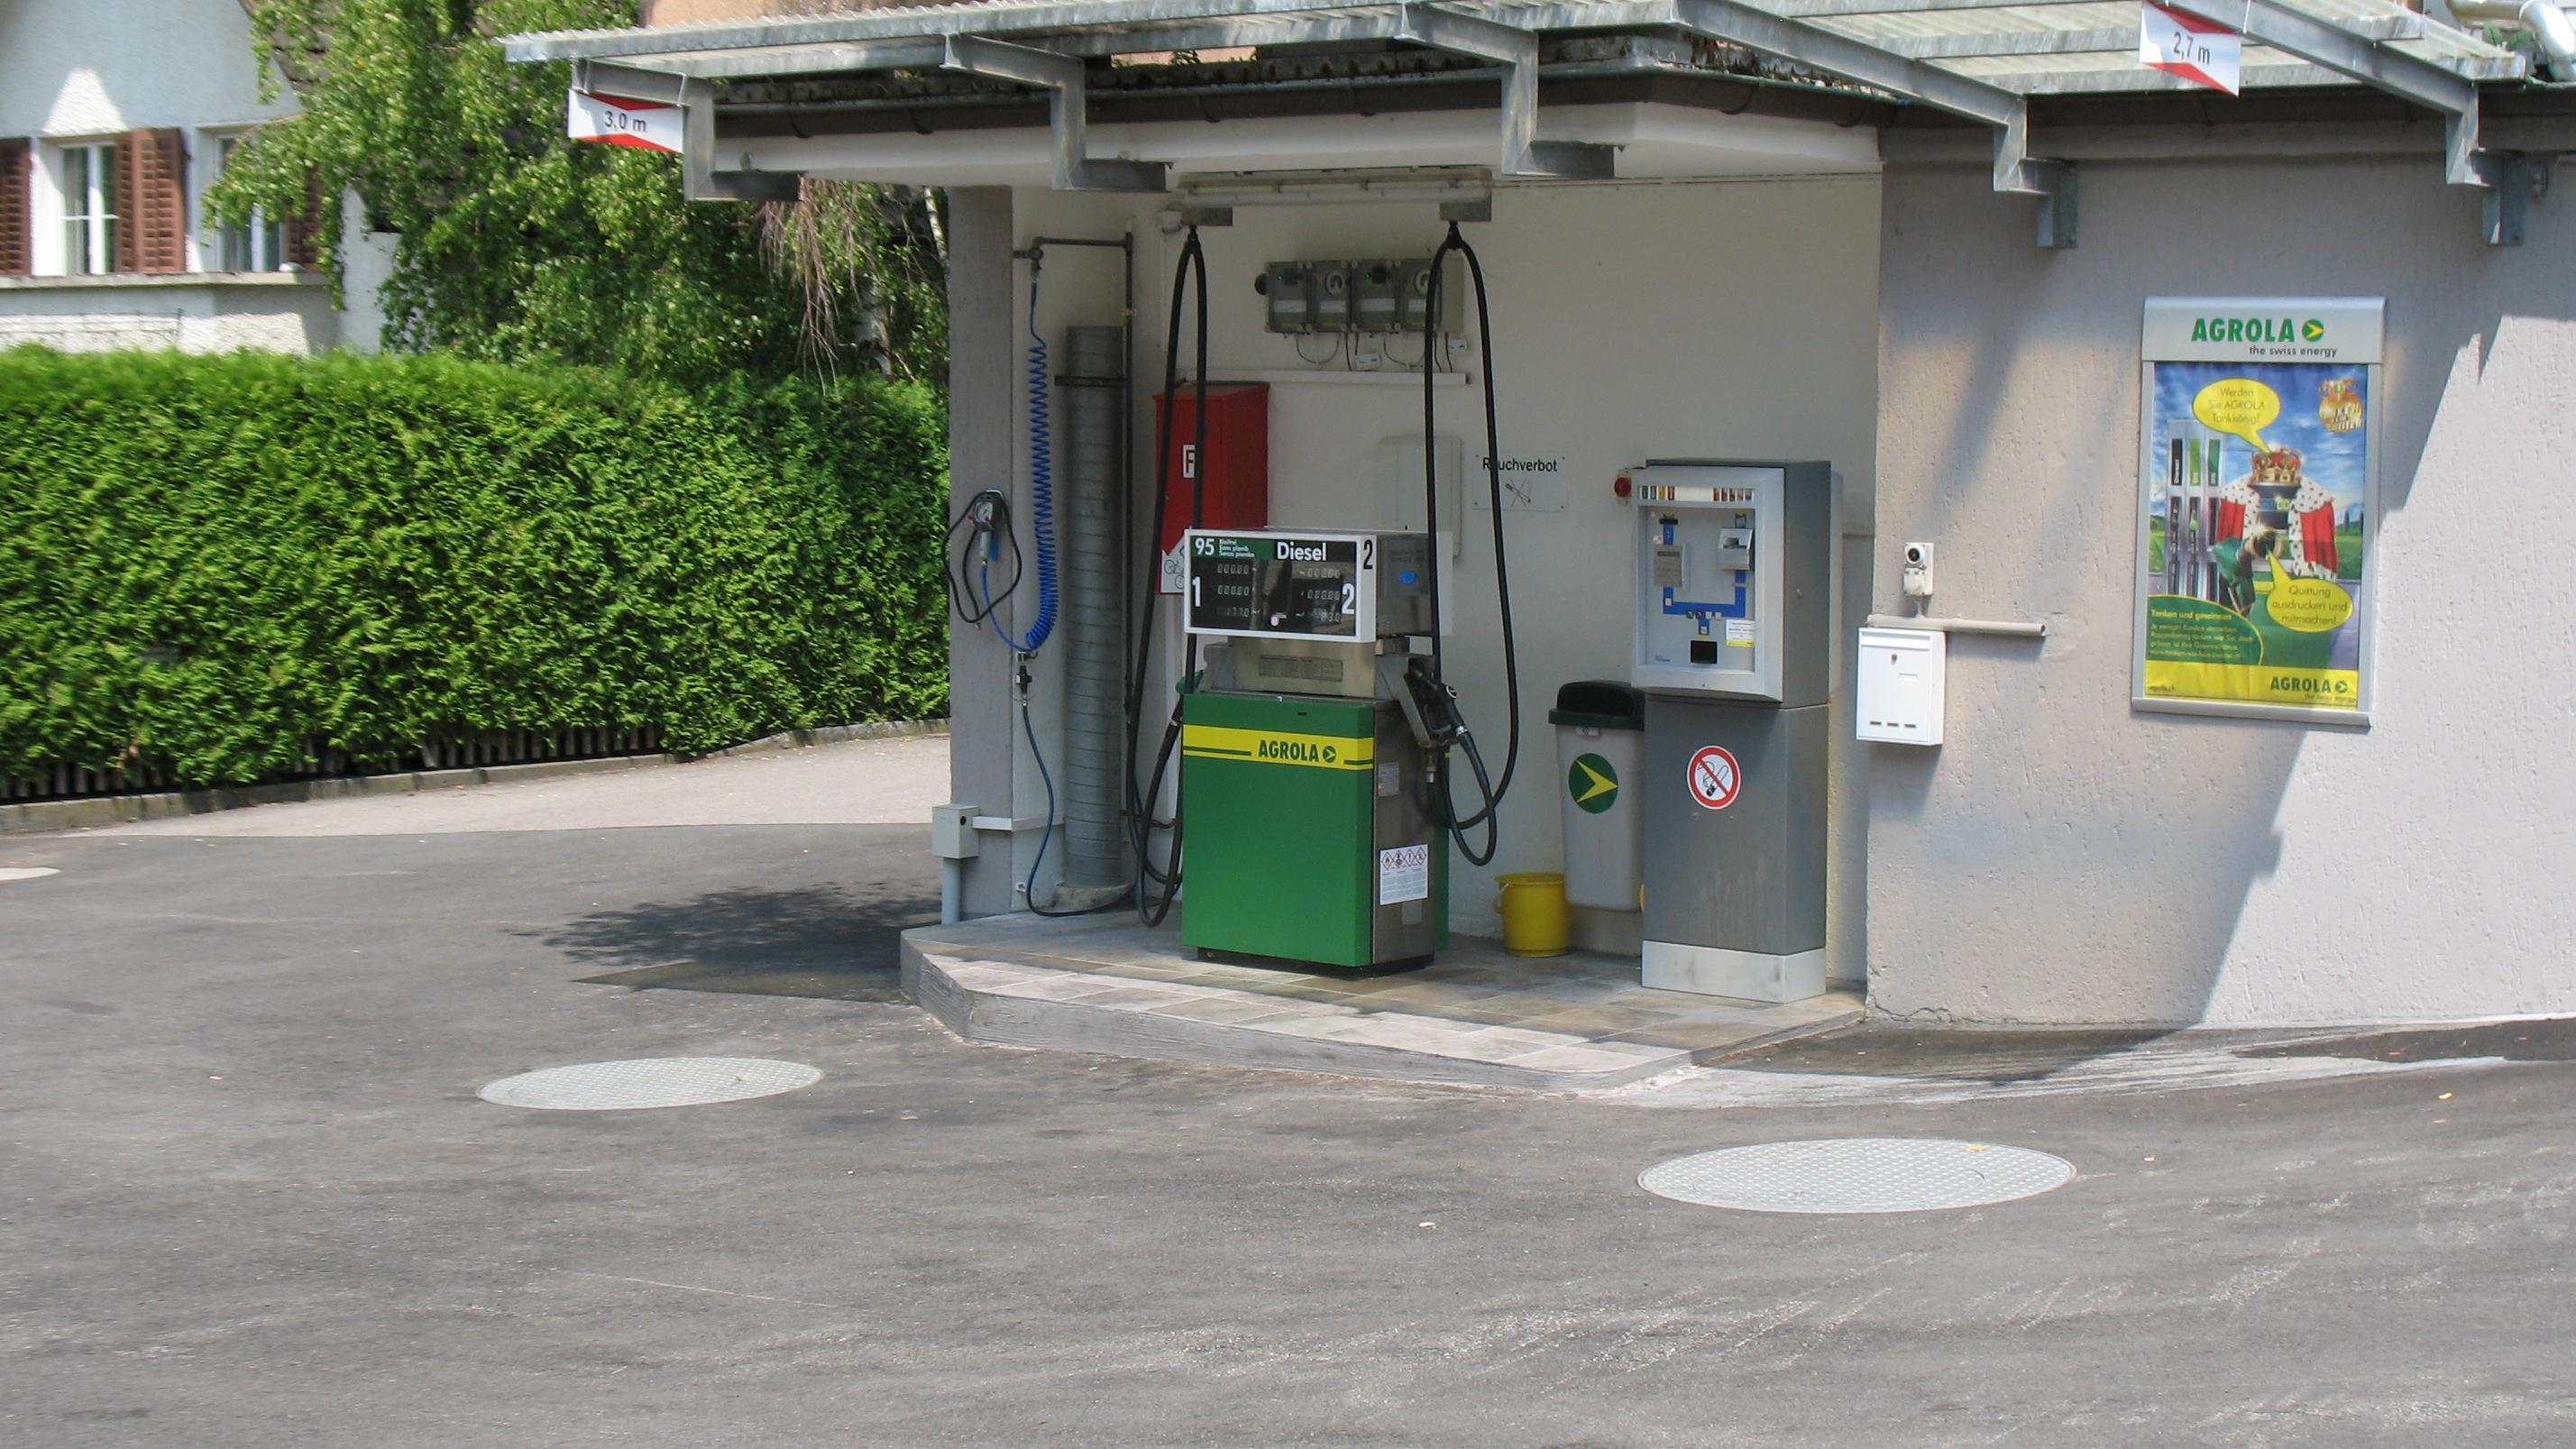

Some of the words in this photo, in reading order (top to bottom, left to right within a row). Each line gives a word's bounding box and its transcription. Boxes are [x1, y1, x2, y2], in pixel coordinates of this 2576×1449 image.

[2173, 32, 2194, 60] 2,7
[2197, 45, 2211, 65] m
[604, 110, 628, 131] 3,0
[632, 118, 646, 133] m
[2190, 317, 2296, 343] AGROLA
[2249, 345, 2266, 355] the
[2269, 346, 2296, 355] swiss
[2300, 348, 2338, 358] energy
[2221, 385, 2254, 397] Werden
[2223, 399, 2266, 410] AGROLA
[1482, 456, 1557, 472] Ruchverbot
[1195, 537, 1215, 556] 95
[1277, 541, 1327, 561] Diesel
[1363, 539, 1373, 570] 2
[1192, 576, 1201, 607] 1
[1341, 582, 1355, 615] 2
[2288, 585, 2331, 599] Quittung
[2272, 599, 2325, 610] ausdrucken
[2329, 601, 2348, 611] und
[2282, 614, 2337, 625] mitmachen!
[2270, 676, 2332, 693] AGROLA
[1258, 738, 1320, 763] AGROLA
